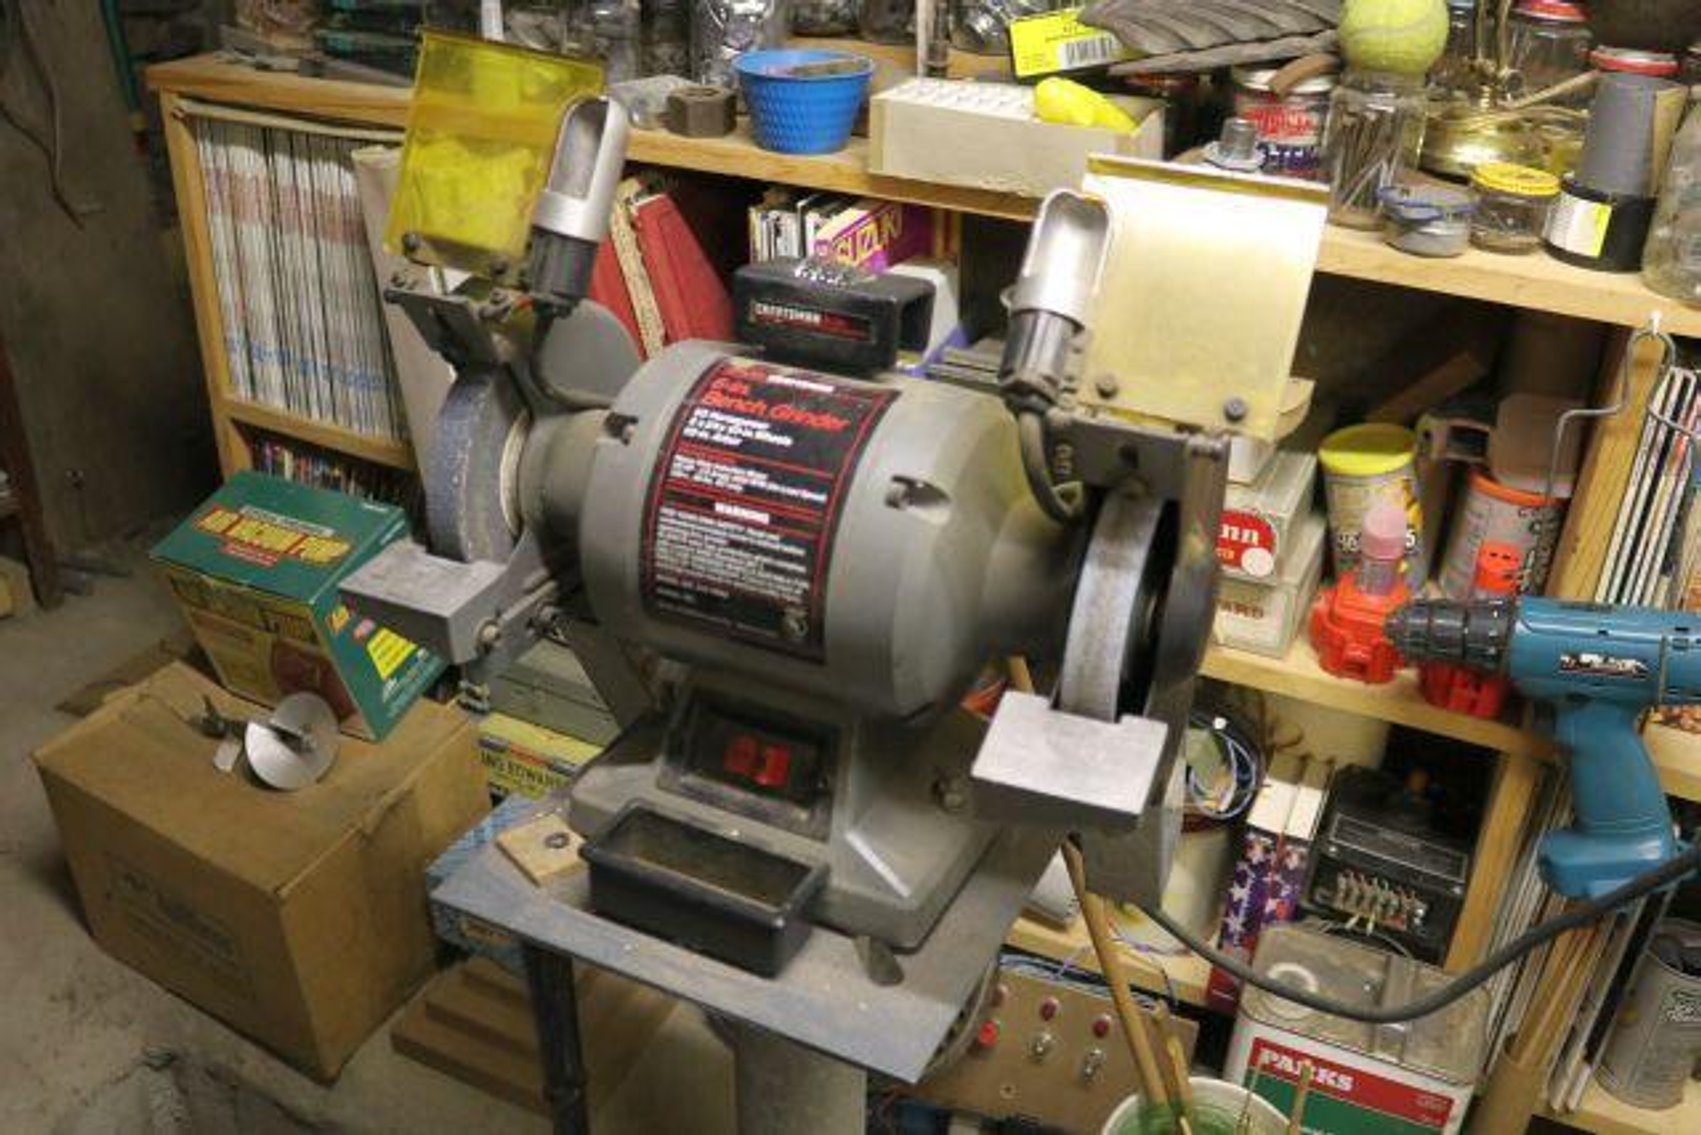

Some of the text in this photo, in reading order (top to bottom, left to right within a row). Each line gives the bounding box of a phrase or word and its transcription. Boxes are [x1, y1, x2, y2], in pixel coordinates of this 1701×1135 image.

[701, 391, 768, 418] Bench
[769, 403, 850, 433] Grinder
[1219, 522, 1260, 547] nn
